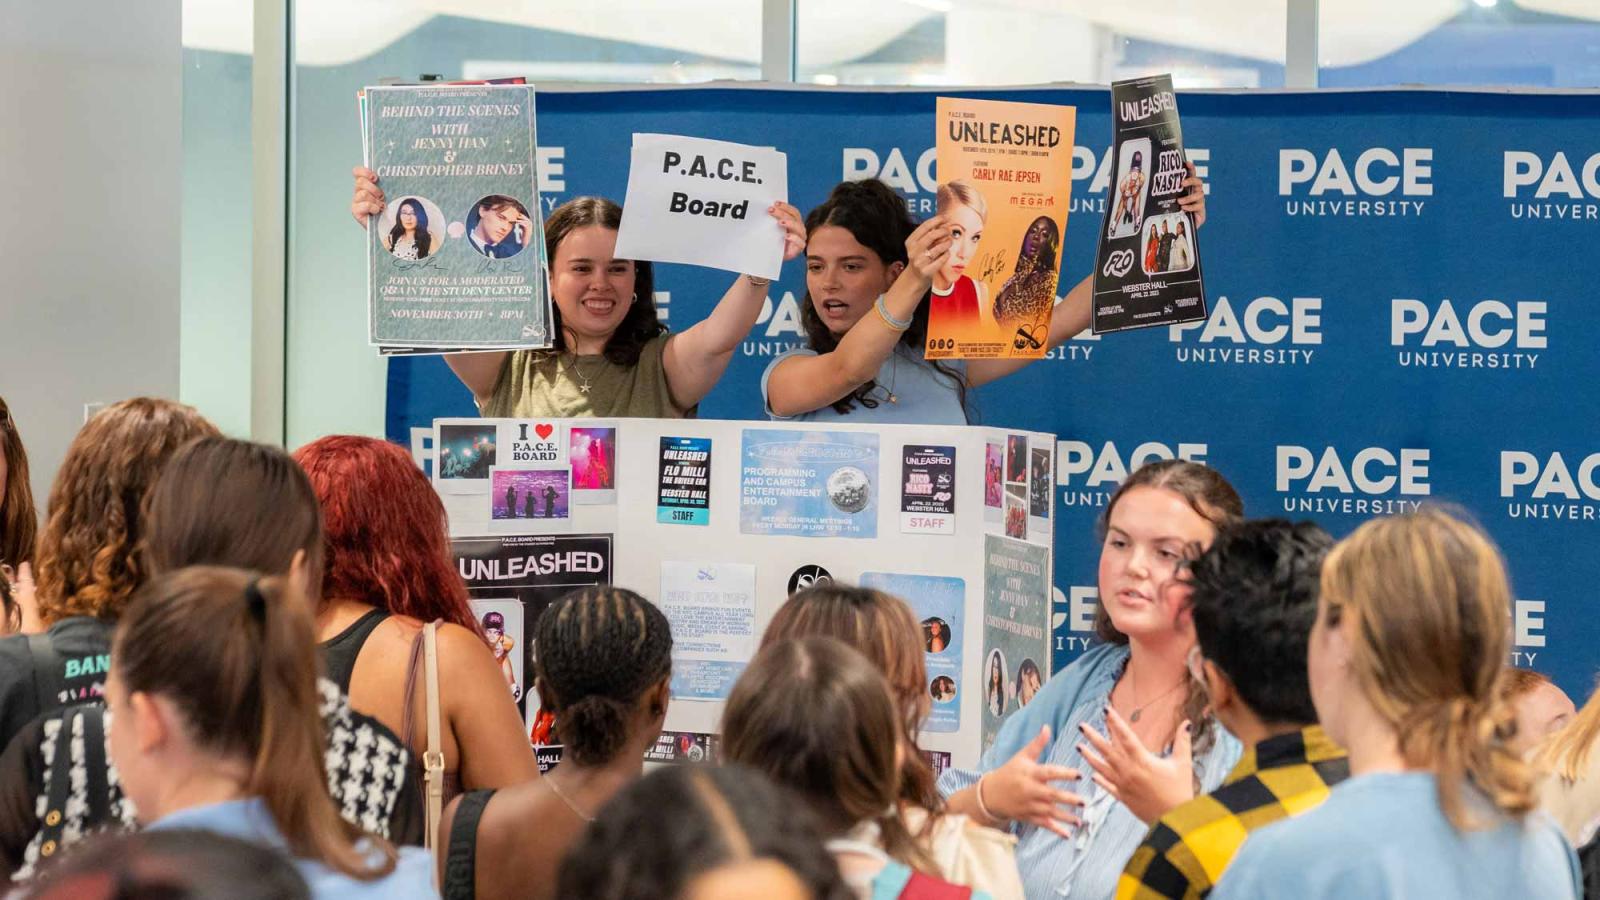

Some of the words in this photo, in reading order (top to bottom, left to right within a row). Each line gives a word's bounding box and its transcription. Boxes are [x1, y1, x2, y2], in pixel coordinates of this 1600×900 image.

[381, 105, 434, 118] BEHIND
[437, 104, 465, 117] THE
[468, 103, 521, 116] SCENES
[1120, 92, 1175, 122] UNLEASHED
[431, 123, 470, 136] WITH
[949, 120, 1061, 148] UNLEASHED
[411, 138, 454, 150] JENNY
[458, 137, 488, 149] HAN
[443, 150, 457, 163] &
[1159, 149, 1182, 172] RICO
[377, 165, 473, 177] CHRISTOPHER
[475, 163, 527, 176] BRINEY
[663, 151, 763, 185] P.A.C.E.
[843, 148, 937, 193] PAC
[1279, 147, 1433, 196] PACE
[972, 168, 996, 181] CARLY
[998, 169, 1013, 182] RAE
[1015, 170, 1041, 184] JEPSEN
[1151, 168, 1187, 196] NASTY
[669, 192, 749, 220] Board
[1286, 201, 1425, 216] UNIVERSITY
[1511, 204, 1598, 219] UNIVER
[1103, 249, 1135, 277] FLO
[388, 276, 410, 286] JOIN
[413, 276, 426, 286] US
[428, 276, 448, 286] FOR
[459, 275, 524, 285] MODERATED
[1121, 283, 1151, 294] WEBSTER
[1151, 281, 1168, 290] HALL
[419, 286, 441, 296] THE
[442, 286, 490, 296] STUDENT
[491, 285, 533, 296] CENTER
[390, 309, 450, 320] NOVEMBER
[453, 309, 484, 320] 30TH
[500, 309, 524, 320] 8PM
[1391, 299, 1548, 349] PACE
[1177, 348, 1314, 364] UNIVERSITY
[1399, 352, 1539, 368] UNIVERSITY
[519, 424, 528, 441] I
[512, 442, 558, 452] P.A.C.E.
[513, 452, 557, 461] BOARD
[663, 450, 708, 461] UNLEASHED
[905, 456, 952, 465] UNLEASHED
[664, 465, 680, 476] FLO
[681, 466, 706, 477] MILLI
[743, 467, 816, 478] PROGRAMMING
[1276, 445, 1430, 495] PACE
[1500, 450, 1600, 501] PAC
[743, 477, 764, 486] AND
[766, 478, 806, 487] CAMPUS
[661, 488, 690, 498] WEBSTER
[691, 490, 707, 499] HALL
[743, 487, 821, 497] ENTERTAINMENT
[743, 496, 778, 506] BOARD
[1284, 498, 1422, 515] UNIVERSITY
[672, 511, 694, 520] STAFF
[1508, 504, 1600, 520] UNIVER
[910, 518, 945, 528] STAFF
[459, 551, 604, 581] UNLEASHED
[65, 654, 110, 679] BAN
[656, 745, 674, 753] MILLI
[537, 753, 561, 764] HALL
